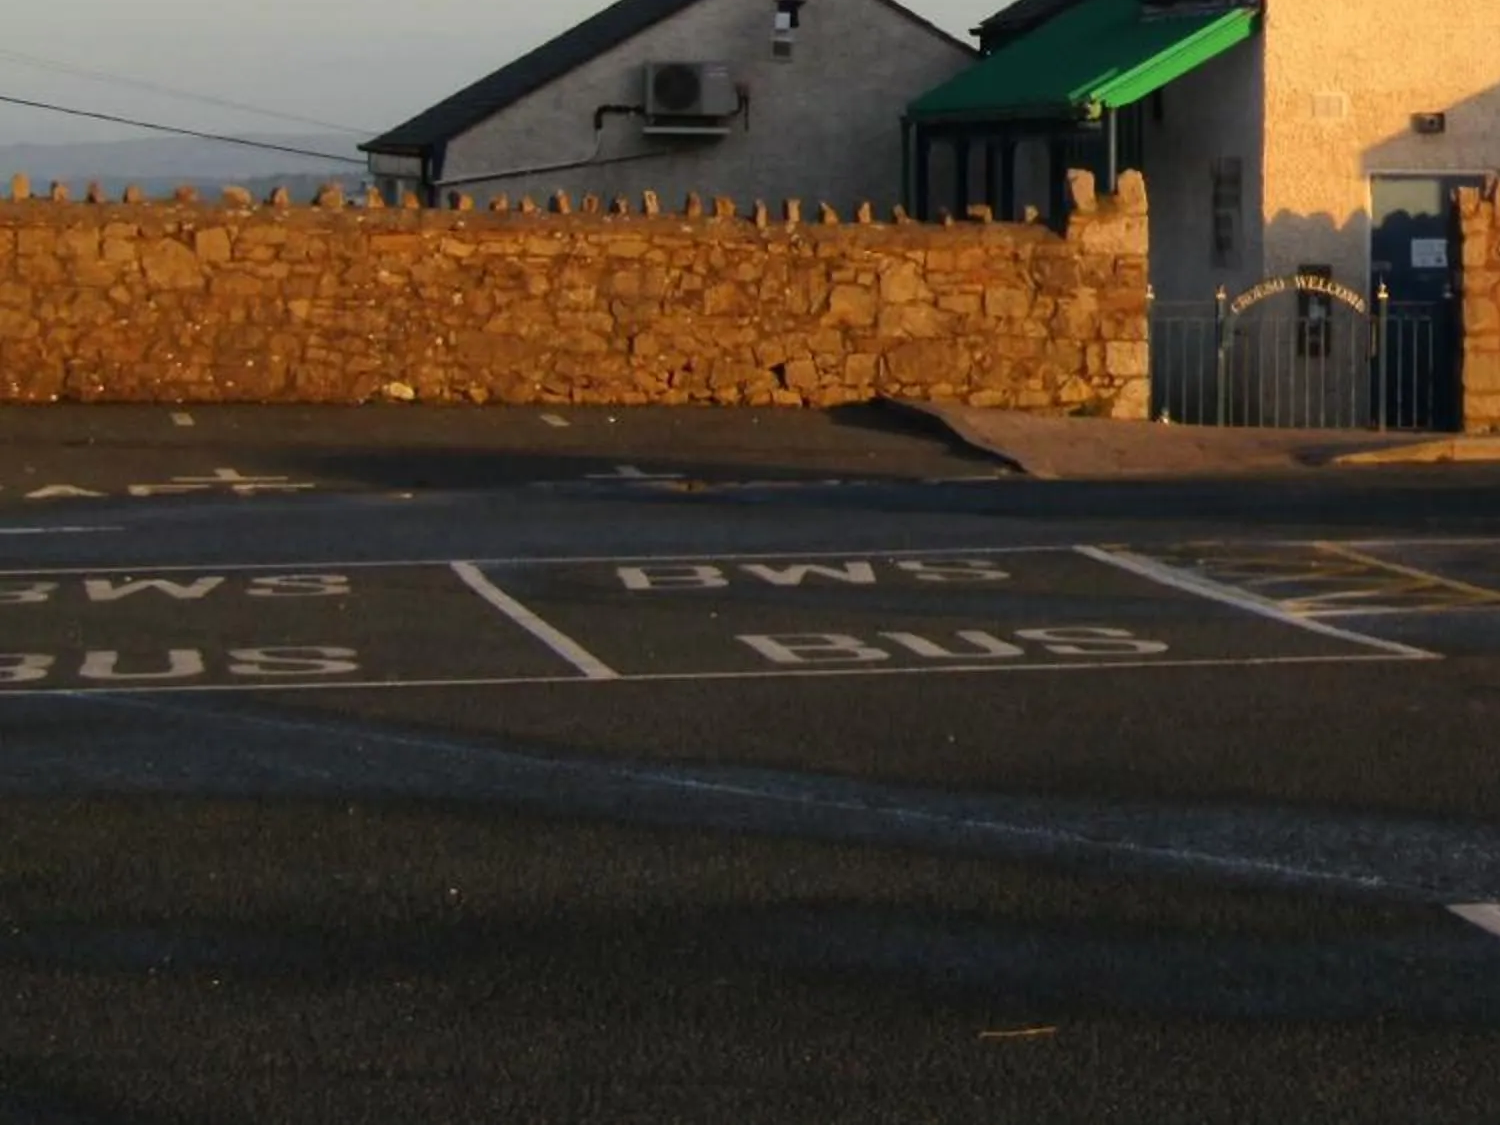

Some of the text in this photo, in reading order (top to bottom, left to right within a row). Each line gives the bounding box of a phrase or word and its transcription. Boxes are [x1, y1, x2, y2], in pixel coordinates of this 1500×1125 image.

[1295, 274, 1366, 314] WELCOME
[616, 561, 1010, 589] BWS
[735, 627, 1169, 663] BUS
